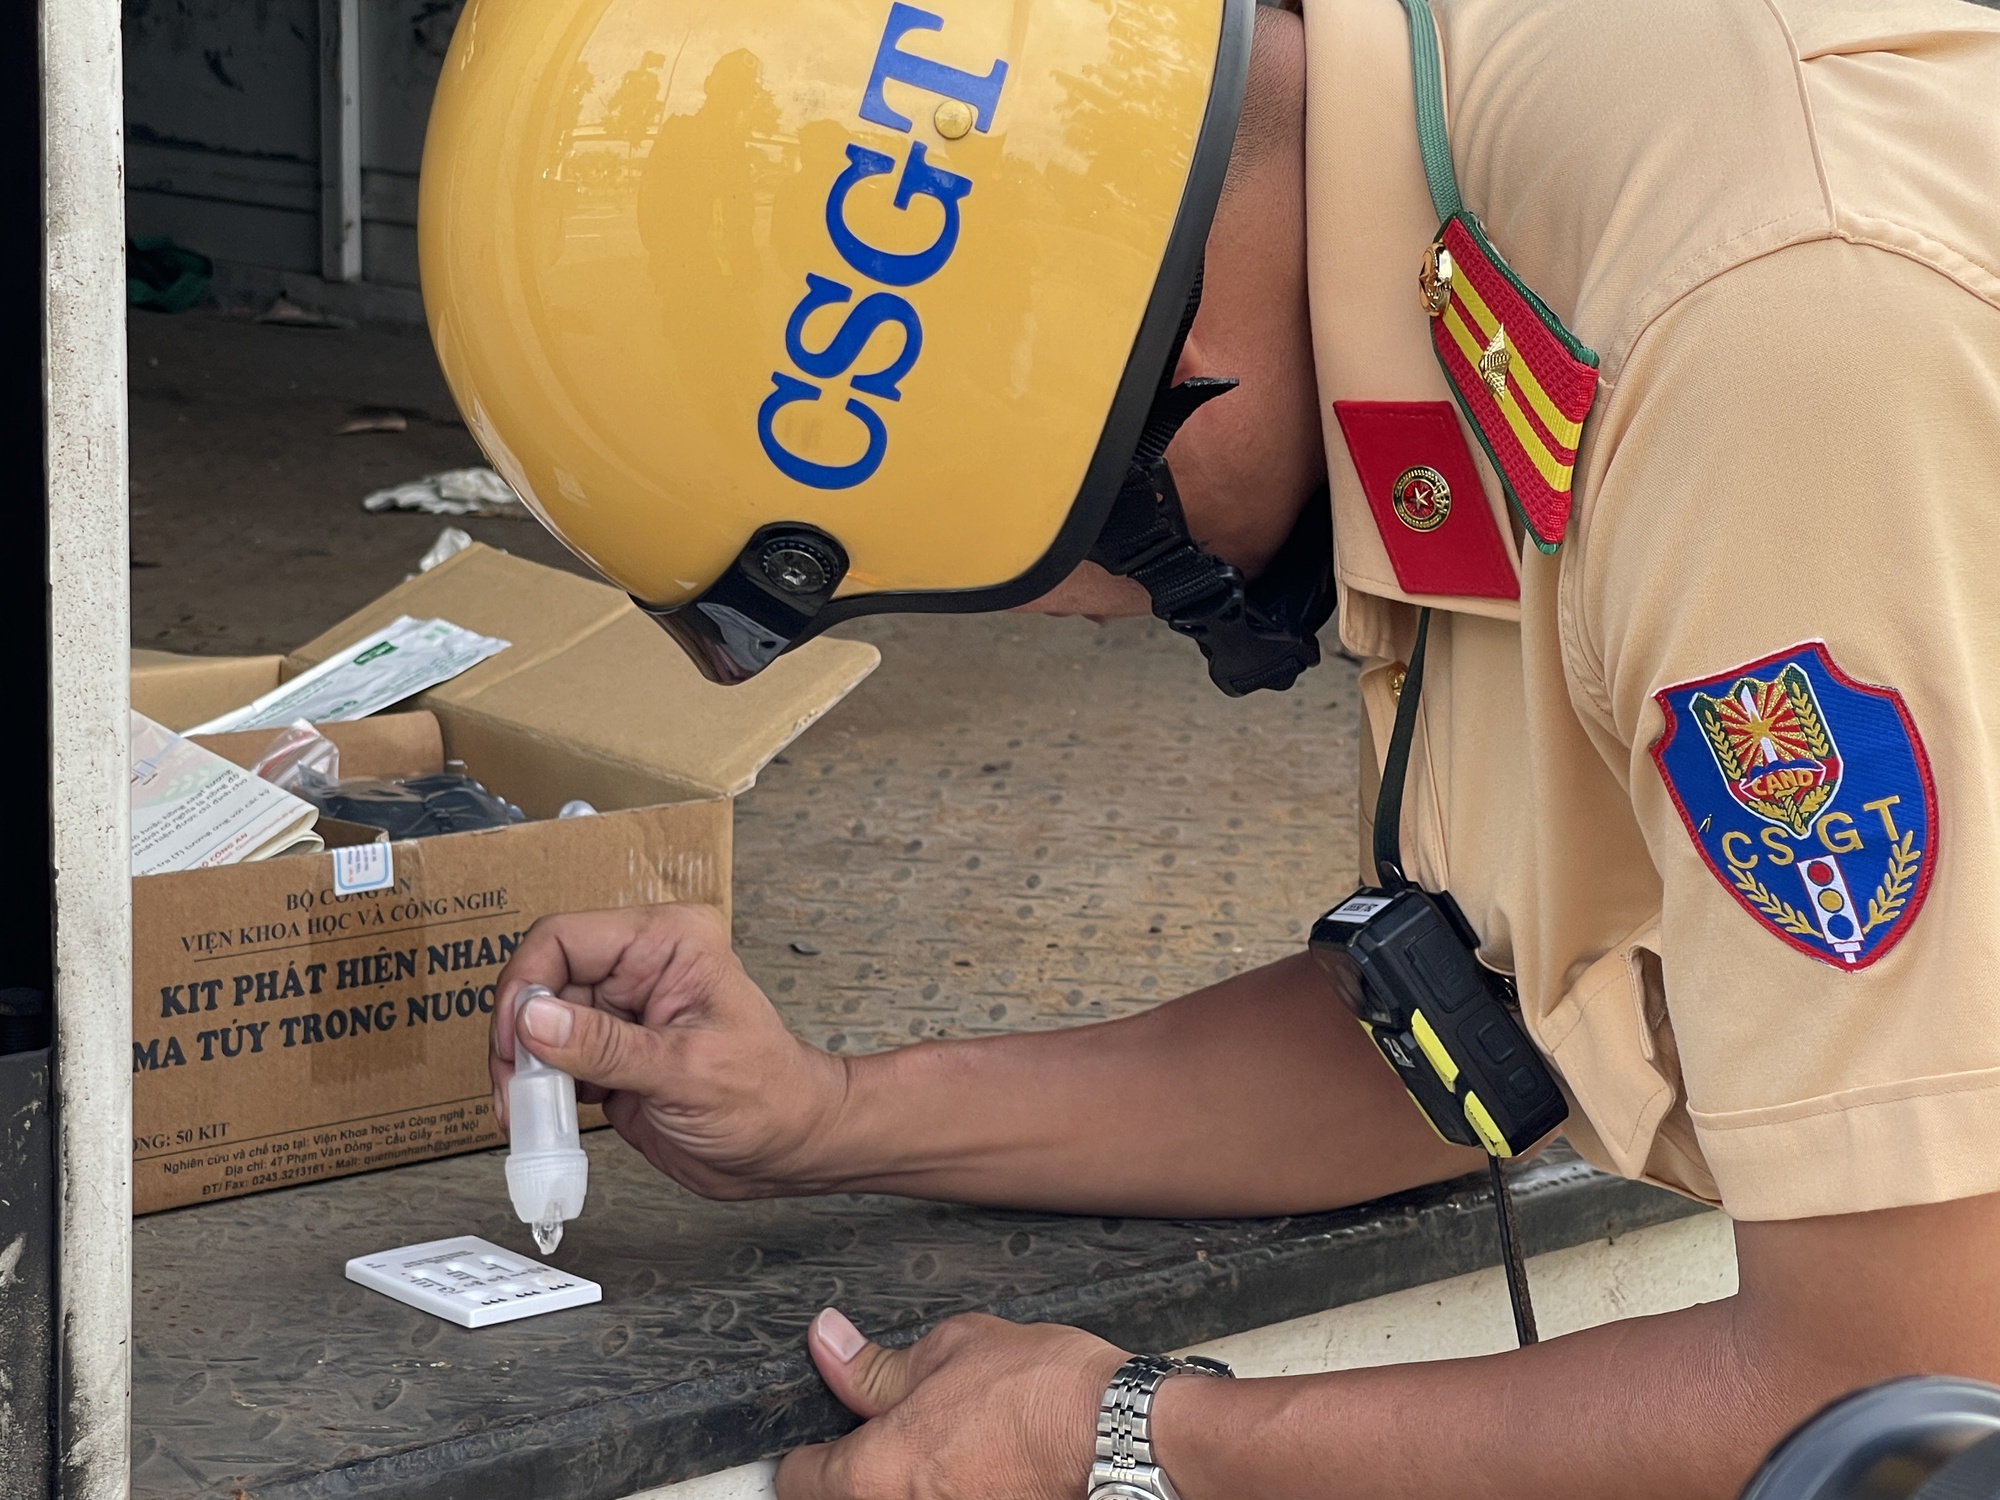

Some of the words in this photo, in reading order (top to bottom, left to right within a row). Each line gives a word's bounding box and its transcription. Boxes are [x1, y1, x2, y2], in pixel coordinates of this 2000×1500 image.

[758, 2, 1009, 490] CSGT
[1751, 769, 1814, 797] CAND
[1722, 795, 1901, 869] CSGT
[181, 929, 232, 955] VIỆN
[240, 921, 301, 945] KHOA
[308, 912, 352, 936] HỌC
[358, 904, 384, 927] VÀ
[391, 897, 448, 922] CÔNG
[453, 886, 509, 913] NGHỆ
[287, 888, 314, 913] BỘ
[161, 979, 223, 1018] KIT
[233, 960, 327, 1007] PHÁT
[336, 945, 418, 990] HIỆN
[427, 930, 528, 976] NHAN
[132, 1036, 188, 1073] MA
[196, 1018, 271, 1061] TÚY
[279, 1001, 398, 1048] TRONG
[163, 1157, 204, 1175] Nghiên
[207, 1152, 230, 1166] cứu
[233, 1146, 247, 1161] và
[248, 1140, 270, 1158] chế
[272, 1142, 290, 1156] tạo
[313, 1132, 337, 1147] Viện
[340, 1128, 368, 1141] Khoa
[371, 1123, 391, 1136] học
[475, 1103, 490, 1116] Bộ
[176, 1128, 193, 1145] 50
[199, 1122, 230, 1141] KIT
[225, 1164, 243, 1178] Địa
[271, 1155, 283, 1167] 47
[286, 1151, 318, 1166] Phạm
[225, 1180, 248, 1191] Fax:
[335, 1157, 362, 1170] Mail:
